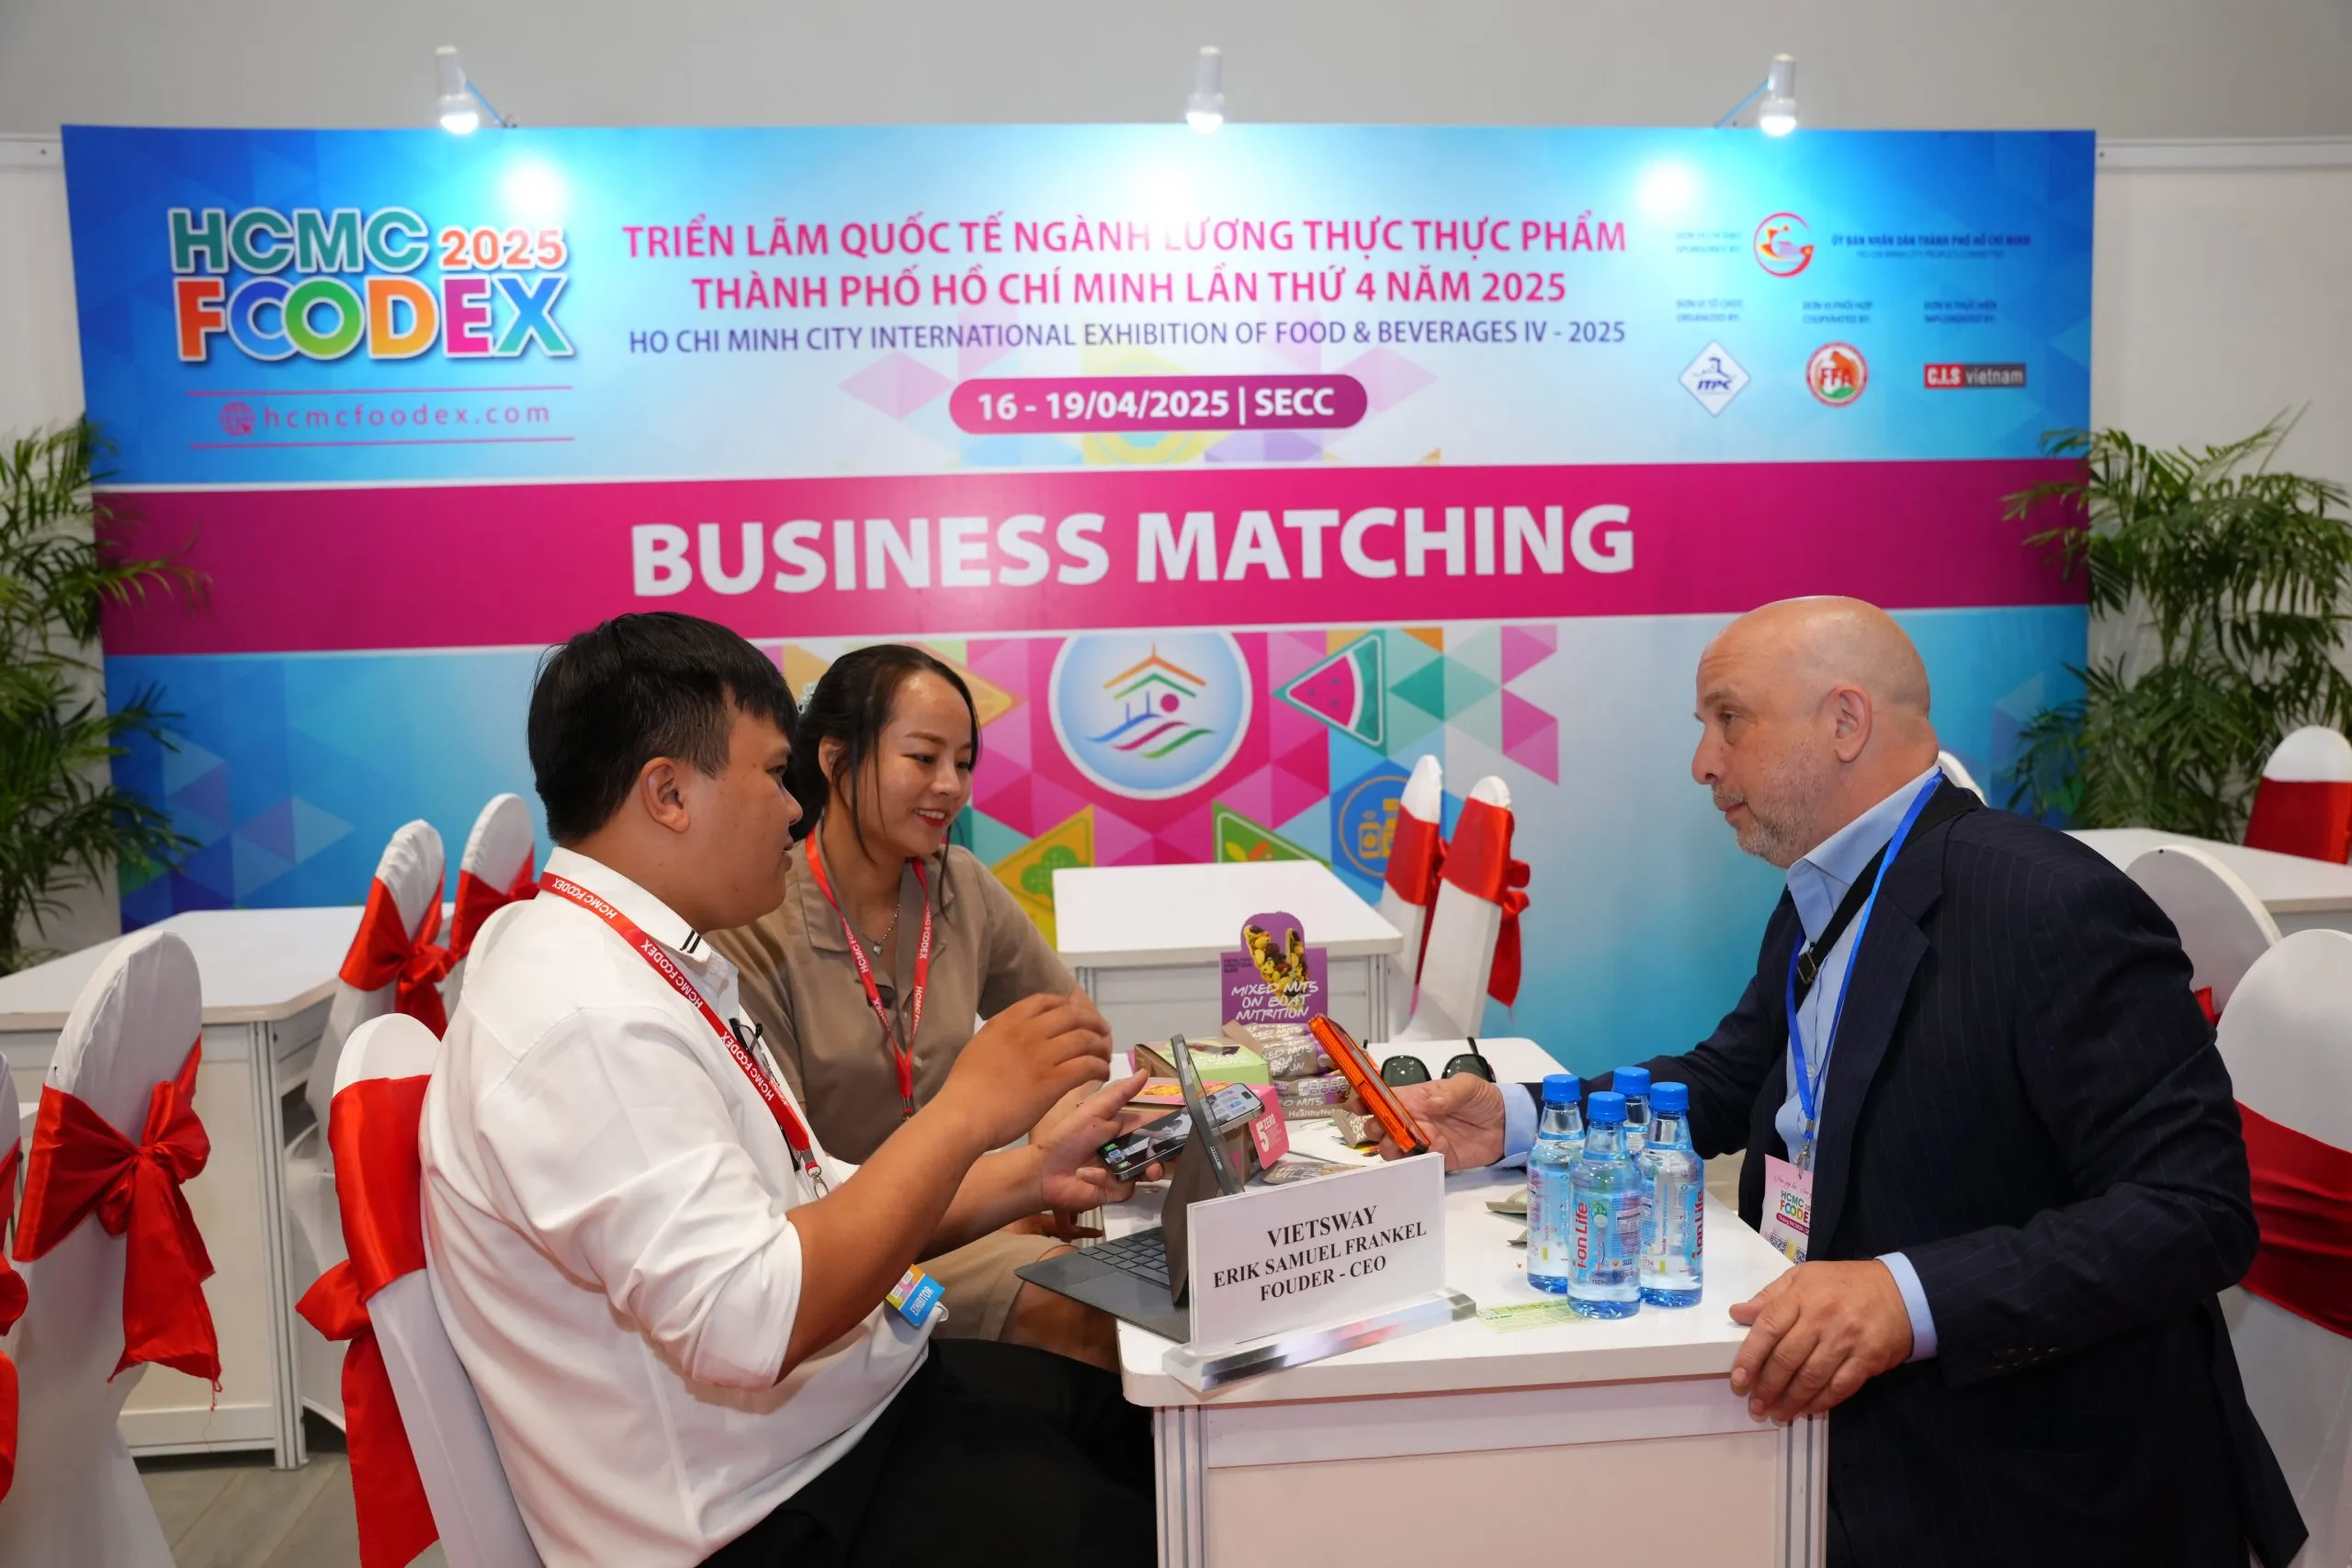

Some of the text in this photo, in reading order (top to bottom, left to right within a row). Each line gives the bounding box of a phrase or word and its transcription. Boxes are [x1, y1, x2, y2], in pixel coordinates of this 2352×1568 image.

[168, 208, 569, 273] HCMC 2025
[622, 209, 1626, 261] TRIỂN LÃM QUỐC TẾ NGÀNH LƯƠNG THỰC THỰC PHẨM
[691, 262, 1566, 310] THÀNH PHỐ HỒ CHÍ MINH LẦN THỨ 4 NĂM 2025
[174, 275, 576, 361] FOODEX
[629, 329, 669, 354] HO
[675, 329, 719, 354] CHI
[728, 328, 798, 352] MINH
[807, 327, 864, 351] CITY
[872, 323, 1076, 349] INTERNATIONAL
[1084, 321, 1227, 346] EXHIBITION
[1235, 321, 1268, 344] OF
[1275, 321, 1346, 344] FOOD
[1353, 321, 1371, 344] &
[1378, 320, 1518, 344] BEVERAGES
[1524, 320, 1548, 344] IV
[1567, 321, 1625, 344] 2025
[1965, 367, 2024, 386] vietnam
[264, 403, 551, 430] hcmcfoodex.com
[977, 393, 1018, 421] 16
[1046, 389, 1229, 421] 19/04/2025
[1254, 387, 1335, 417] SECC
[630, 503, 1634, 597] BUSINESS MATCHING
[583, 895, 617, 919] HCMC
[853, 943, 869, 974] HCMC
[676, 976, 704, 1010] HCMC
[1231, 980, 1319, 997] MIXED NUTS
[1241, 996, 1263, 1009] ON
[1235, 1006, 1309, 1022] NUTRITION
[750, 1067, 775, 1101] HCMC
[1296, 1097, 1324, 1107] NUTS
[1255, 1120, 1271, 1153] 5
[1780, 1199, 1810, 1224] FOODE
[1781, 1190, 1804, 1208] HCMC
[1266, 1205, 1378, 1248] VIETSWAY
[1575, 1201, 1589, 1235] Life
[1212, 1221, 1428, 1289] ERIK SAMUEL FRANKEL
[1260, 1268, 1336, 1303] FOUDER
[1350, 1255, 1386, 1279] CEO
